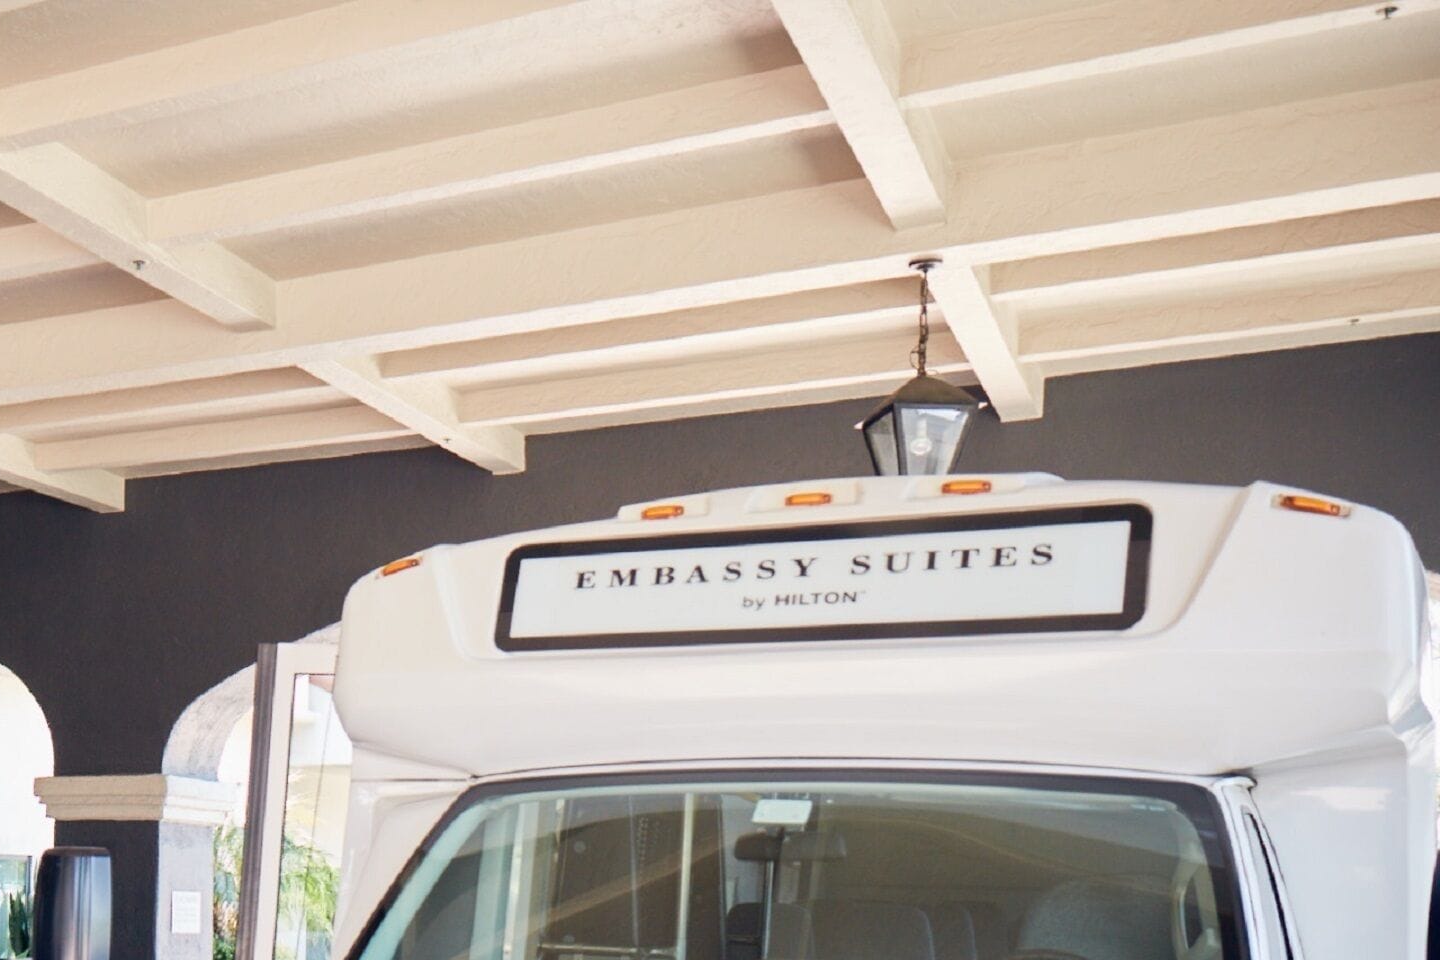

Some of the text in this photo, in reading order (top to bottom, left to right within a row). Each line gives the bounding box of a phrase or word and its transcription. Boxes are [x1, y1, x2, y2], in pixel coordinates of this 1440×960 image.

[573, 543, 1054, 590] EMBASSY SUITES
[742, 591, 858, 611] by HILTON
